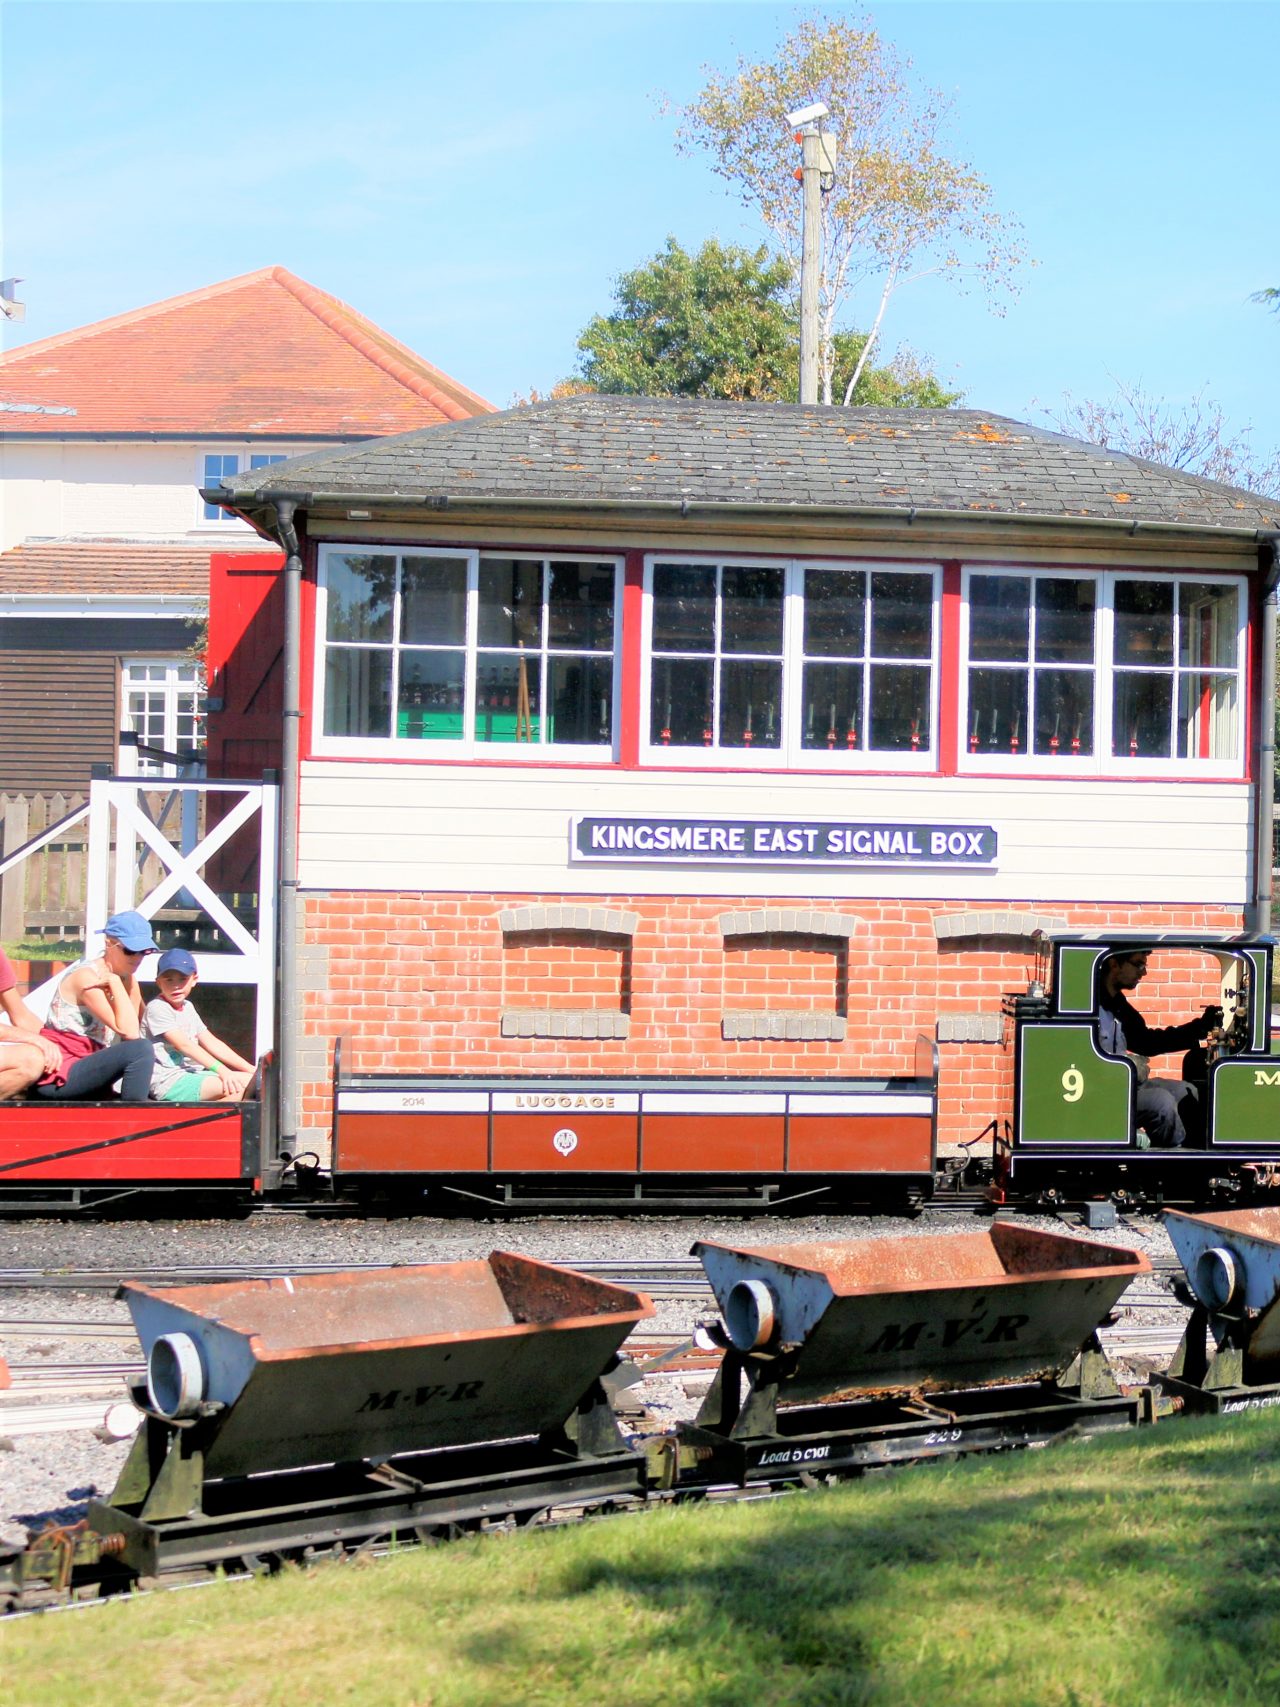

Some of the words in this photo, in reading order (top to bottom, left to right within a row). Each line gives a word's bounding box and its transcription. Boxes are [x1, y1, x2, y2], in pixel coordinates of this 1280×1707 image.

[592, 825, 745, 851] KINGSMERE
[754, 828, 818, 853] EAST
[826, 829, 922, 854] SIGNAL
[930, 832, 984, 855] BOX
[1061, 1068, 1084, 1103] 9
[402, 1097, 426, 1107] 2014
[515, 1095, 615, 1108] LUGGAGE
[758, 1449, 791, 1465] Load
[792, 1447, 802, 1462] 5
